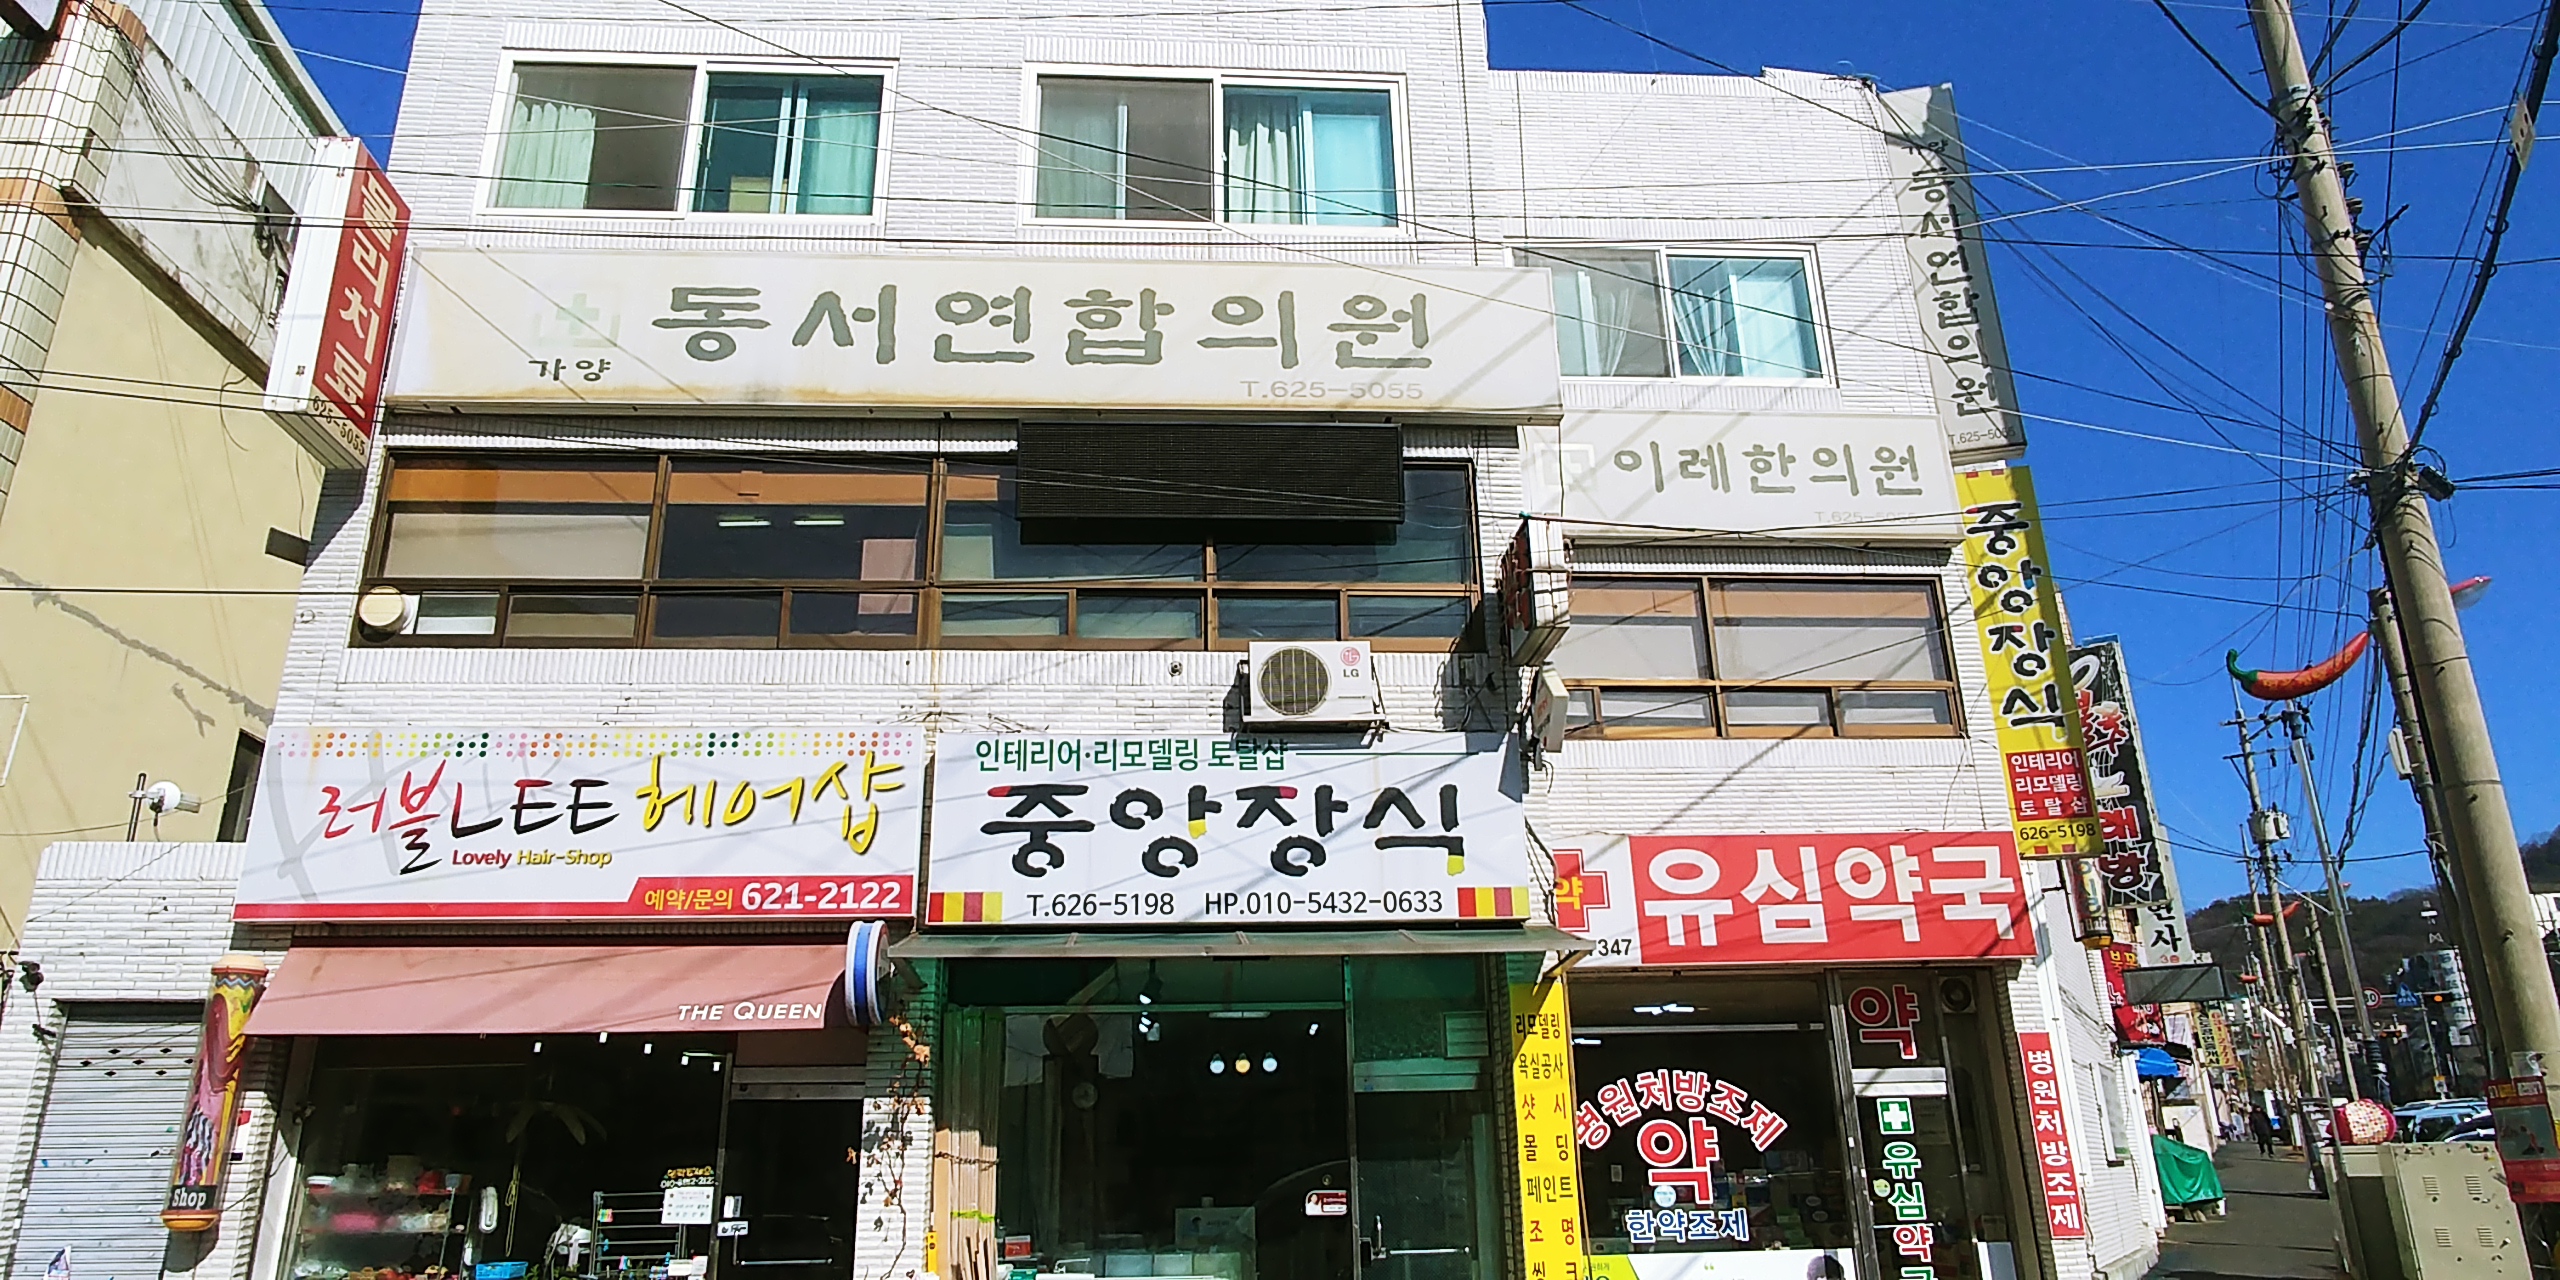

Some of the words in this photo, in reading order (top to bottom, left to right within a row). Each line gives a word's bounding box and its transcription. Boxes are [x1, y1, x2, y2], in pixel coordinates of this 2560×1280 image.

[324, 171, 398, 419] 물리치료
[1908, 166, 1999, 417] 동서연합의원
[652, 283, 1433, 370] 동서연합의원
[528, 357, 611, 382] 가양
[1239, 380, 1424, 400] T.625-5055
[312, 395, 365, 456] 625-5055
[1613, 441, 1923, 496] 이레한의원
[1964, 501, 2068, 742] 중앙장식
[1343, 668, 1359, 678] LG
[975, 737, 1200, 772] 인테리어·리모델링
[1208, 737, 1289, 771] 토탈샵
[2011, 750, 2079, 773] 인테리어
[2015, 773, 2083, 795] 리모델링
[634, 751, 904, 855] 헤어샵
[980, 783, 1465, 878] 중앙장식
[2019, 822, 2096, 841] 626-5198
[452, 849, 512, 869] Lovely
[516, 848, 612, 869] Hair-Shop
[644, 888, 733, 911] 예약/문의
[741, 881, 901, 911] 621-2122
[1026, 892, 1175, 918] T.626-5198
[1205, 891, 1443, 916] HP.010-5432-0633
[1555, 876, 1584, 910] 약
[1643, 844, 2016, 947] 유심약국
[1589, 938, 1632, 957] 347
[678, 1004, 726, 1021] THE
[733, 1001, 822, 1021] QUEEN
[1515, 1012, 1561, 1039] 리모델링
[1850, 985, 1919, 1059] 약
[1518, 1053, 1564, 1079] 욕실공사
[1576, 1069, 1788, 1151] 병원처방조제
[2027, 1049, 2081, 1230] 병원처방조제
[1637, 1116, 1719, 1204] 약
[171, 1187, 207, 1207] Shop
[1527, 1176, 1574, 1203] 페인트
[1625, 1208, 1749, 1243] 한약조제
